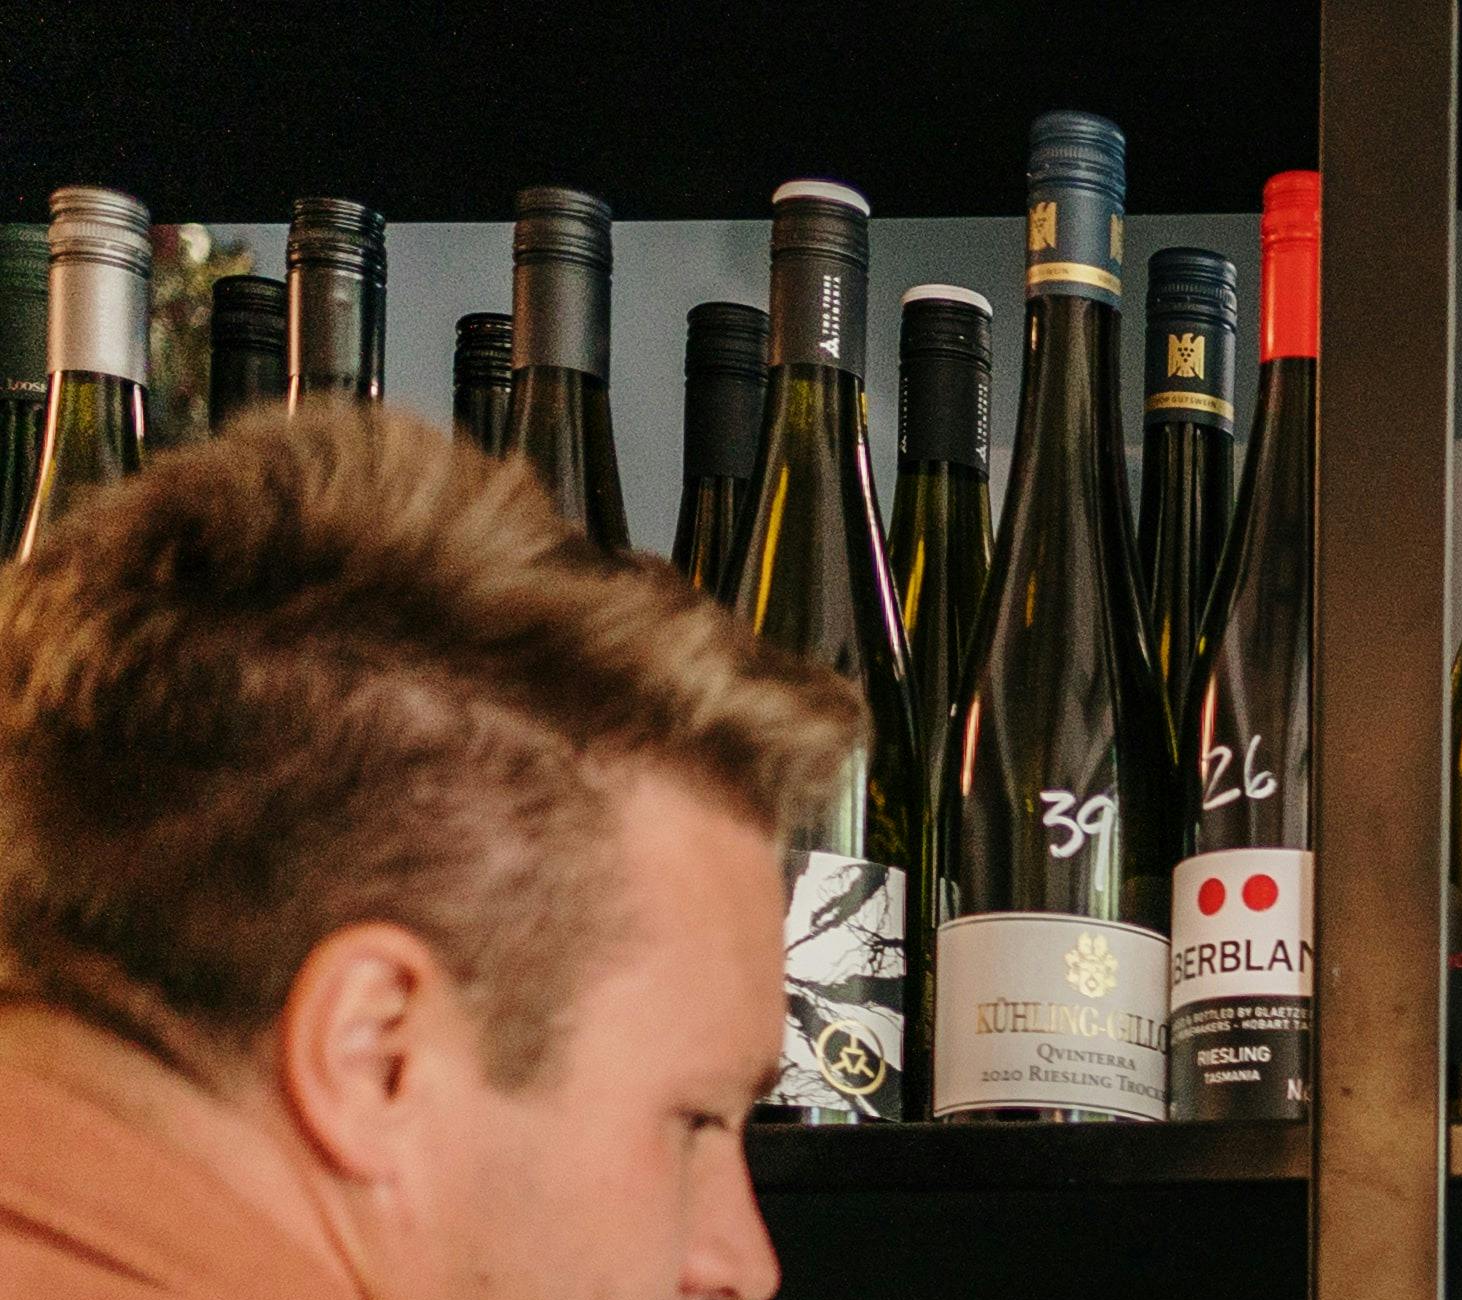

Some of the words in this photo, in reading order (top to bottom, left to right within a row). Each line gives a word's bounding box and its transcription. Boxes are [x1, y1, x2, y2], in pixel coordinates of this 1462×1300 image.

[1201, 734, 1278, 812] 26
[1039, 788, 1119, 892] 39
[1197, 1045, 1272, 1068] RIESLING
